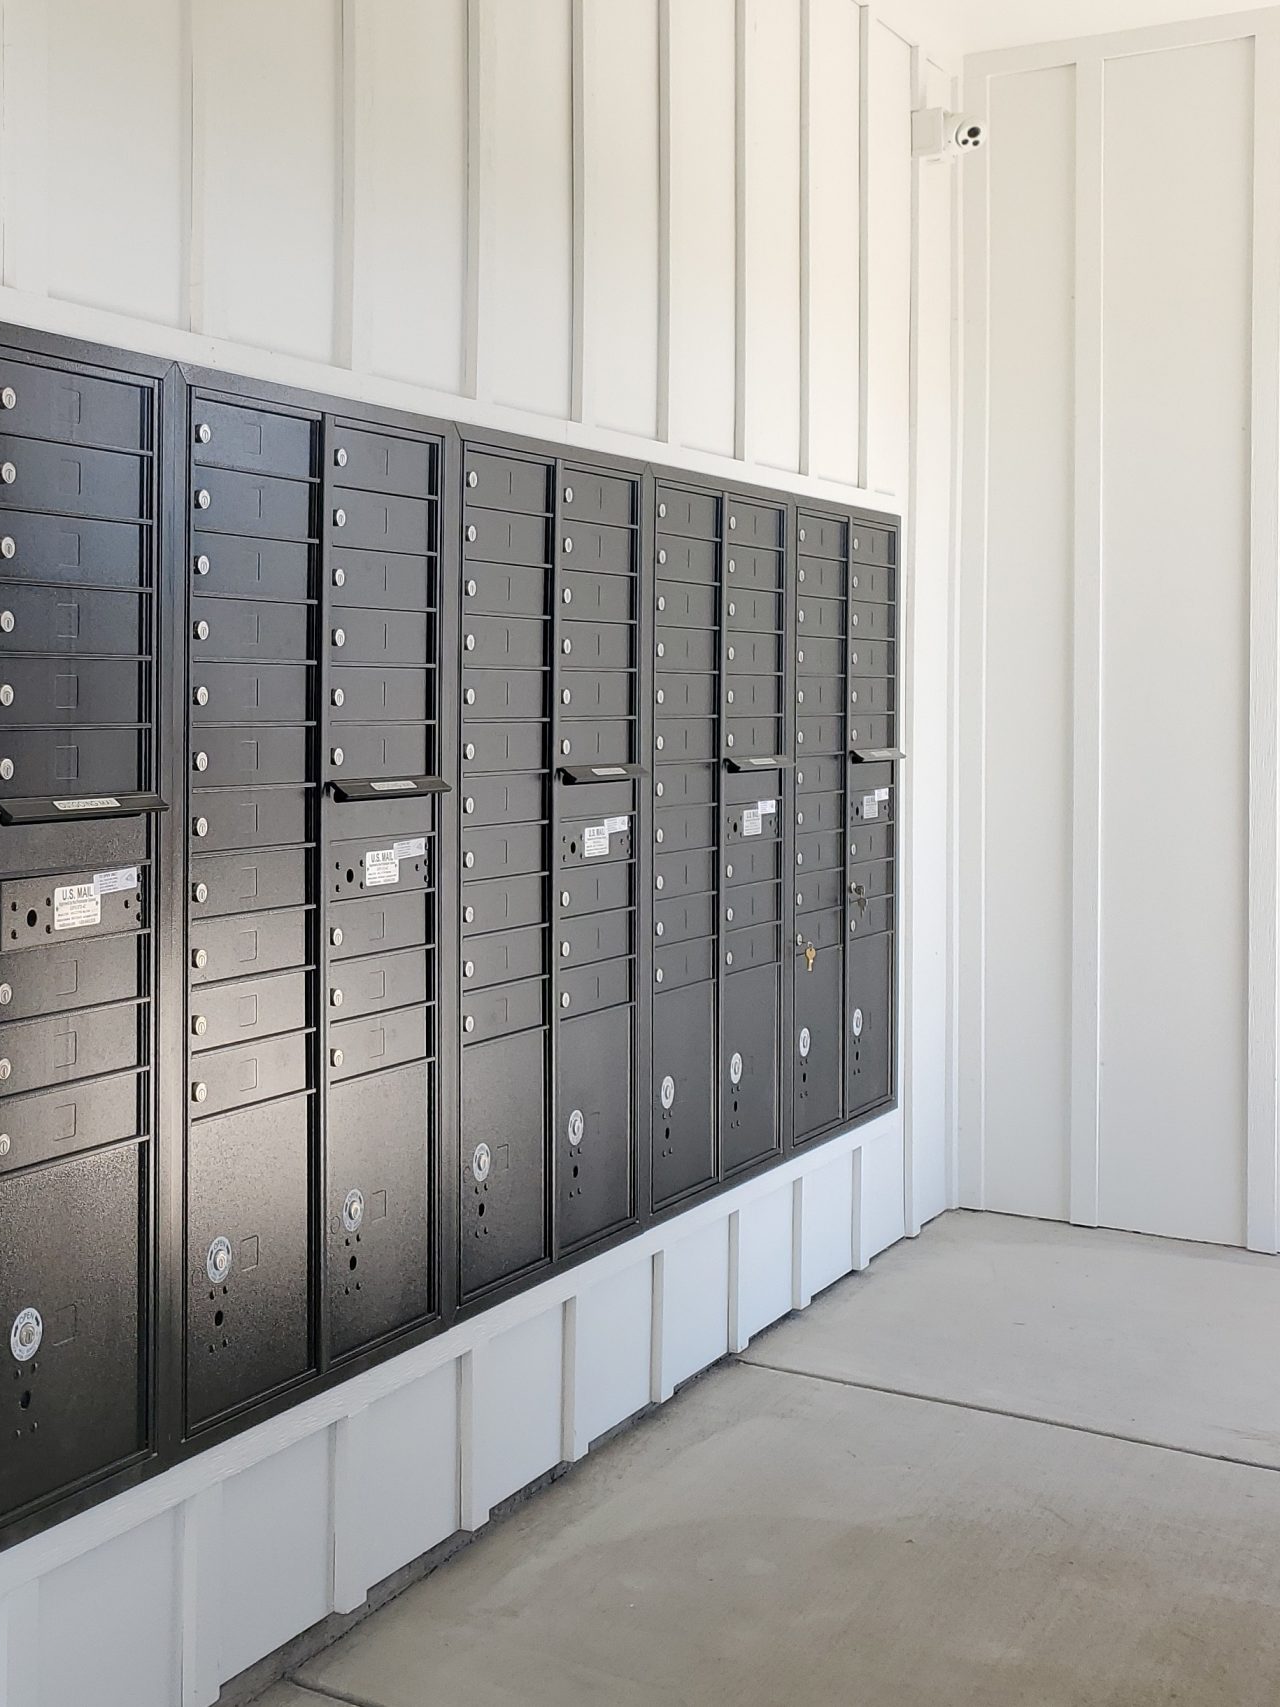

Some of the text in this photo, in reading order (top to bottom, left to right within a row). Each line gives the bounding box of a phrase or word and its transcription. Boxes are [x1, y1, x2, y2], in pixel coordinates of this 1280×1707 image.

[62, 886, 94, 901] U.S. MAIL
[19, 1311, 35, 1324] OPEN
